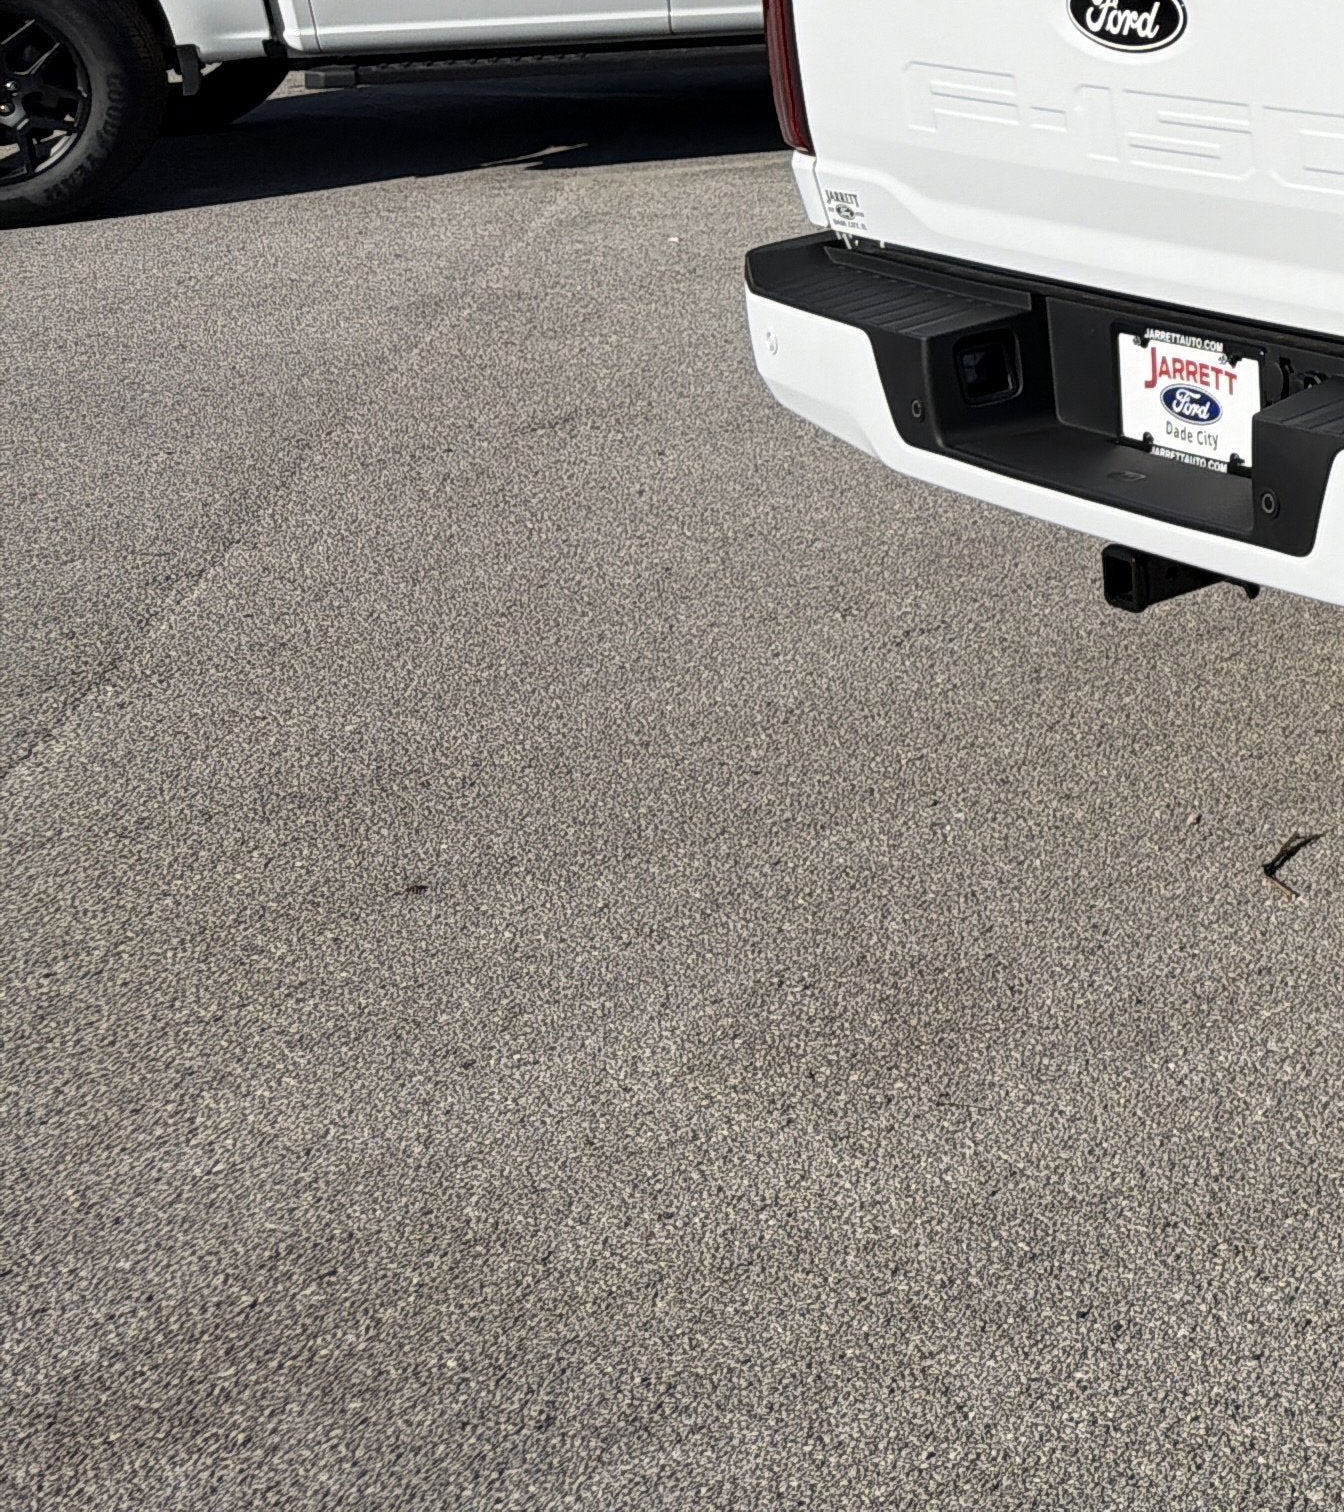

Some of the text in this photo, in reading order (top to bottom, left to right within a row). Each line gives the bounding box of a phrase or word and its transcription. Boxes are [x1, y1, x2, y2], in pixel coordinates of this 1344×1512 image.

[1144, 327, 1224, 352] JARRETTAUTO.COM
[1144, 347, 1237, 395] JARRETT
[1172, 388, 1210, 419] Ford
[1166, 420, 1218, 450] Dade City
